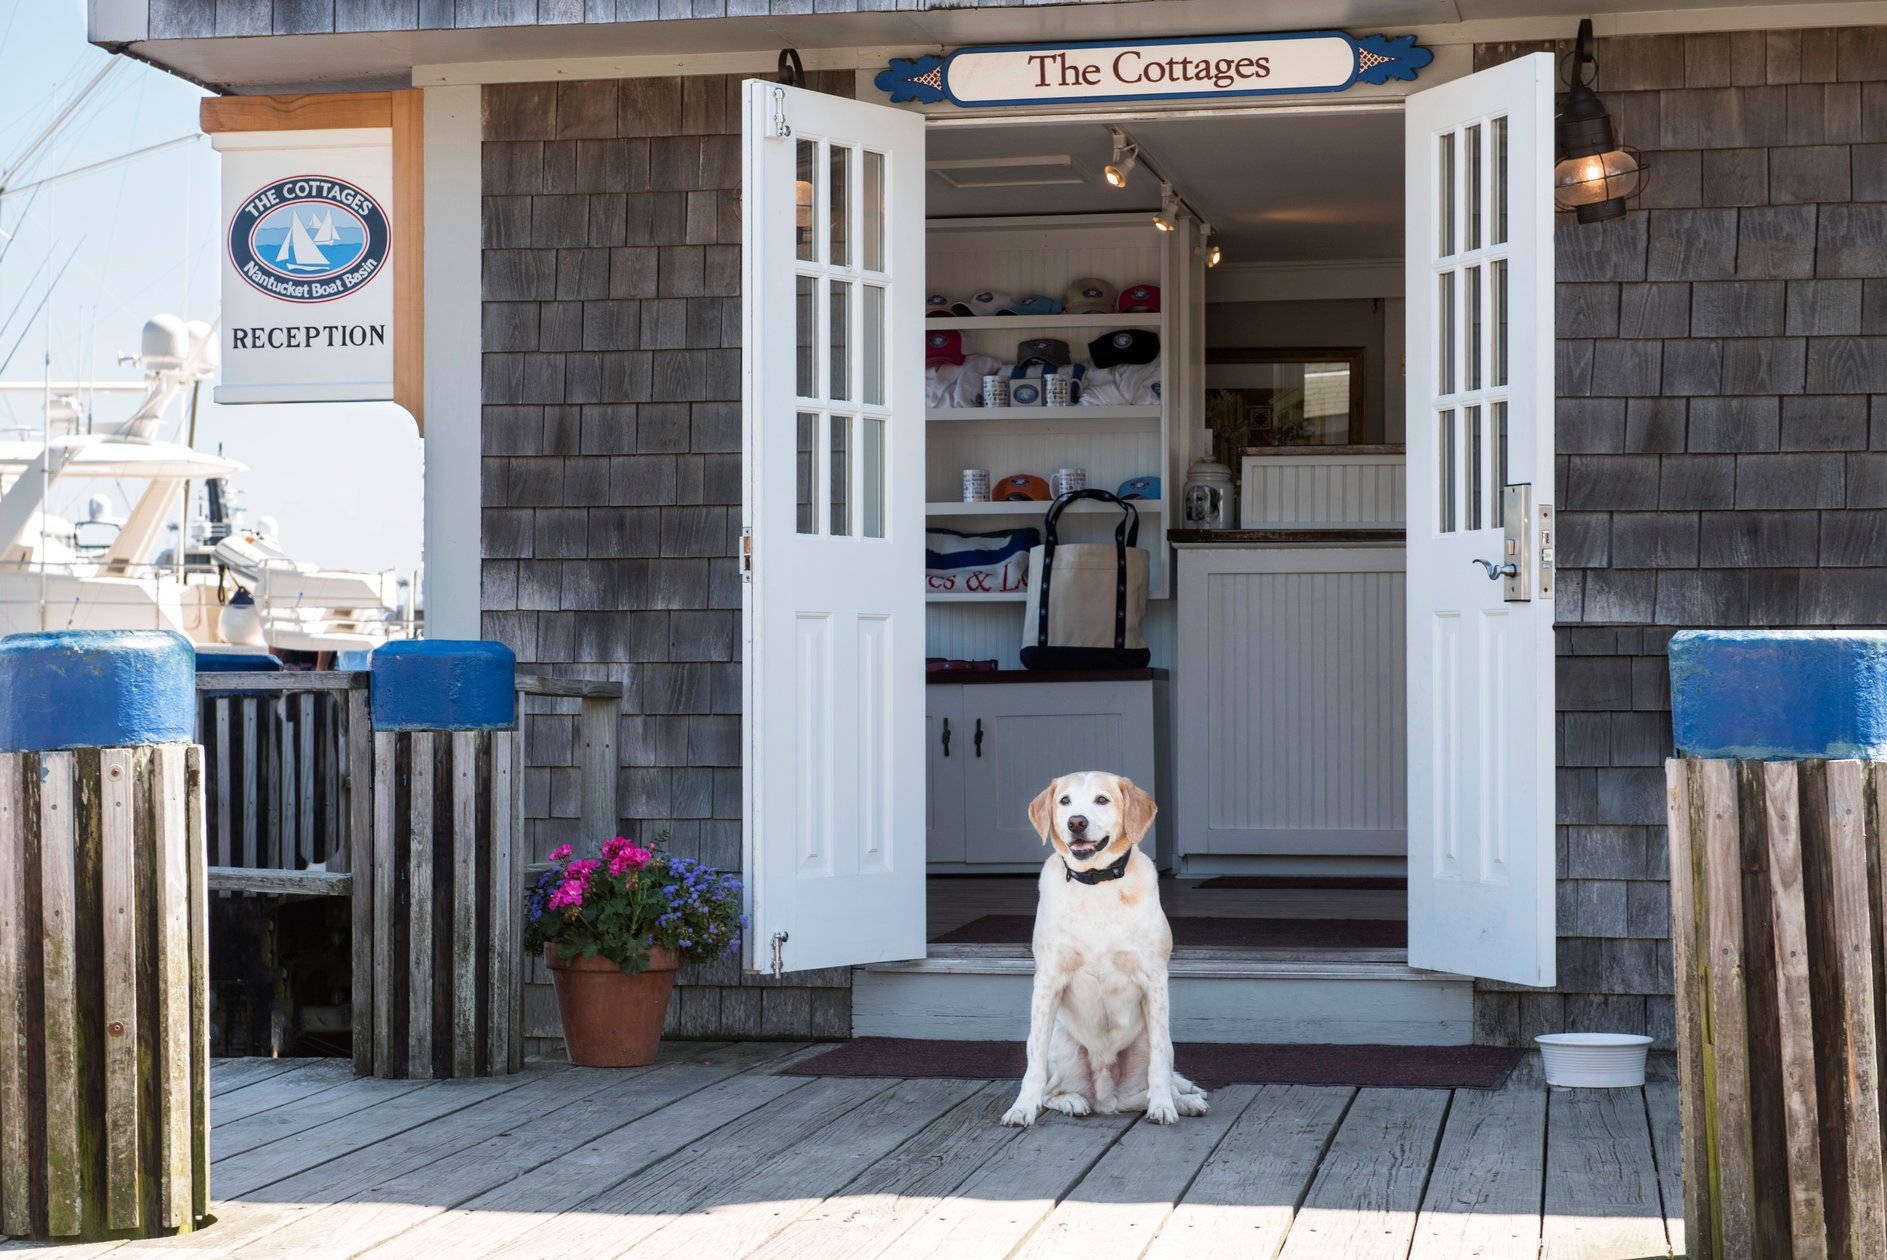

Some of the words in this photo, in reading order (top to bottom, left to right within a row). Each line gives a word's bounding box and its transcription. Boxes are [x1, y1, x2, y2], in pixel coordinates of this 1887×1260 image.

[1027, 52, 1101, 88] The
[1112, 50, 1271, 89] Cottages
[244, 189, 280, 218] THE
[282, 181, 373, 217] COTTAGES
[243, 260, 310, 298] Nantucket
[311, 279, 344, 297] Boat
[343, 258, 378, 287] Basin
[231, 324, 386, 350] RECEPTION
[965, 570, 994, 592] &
